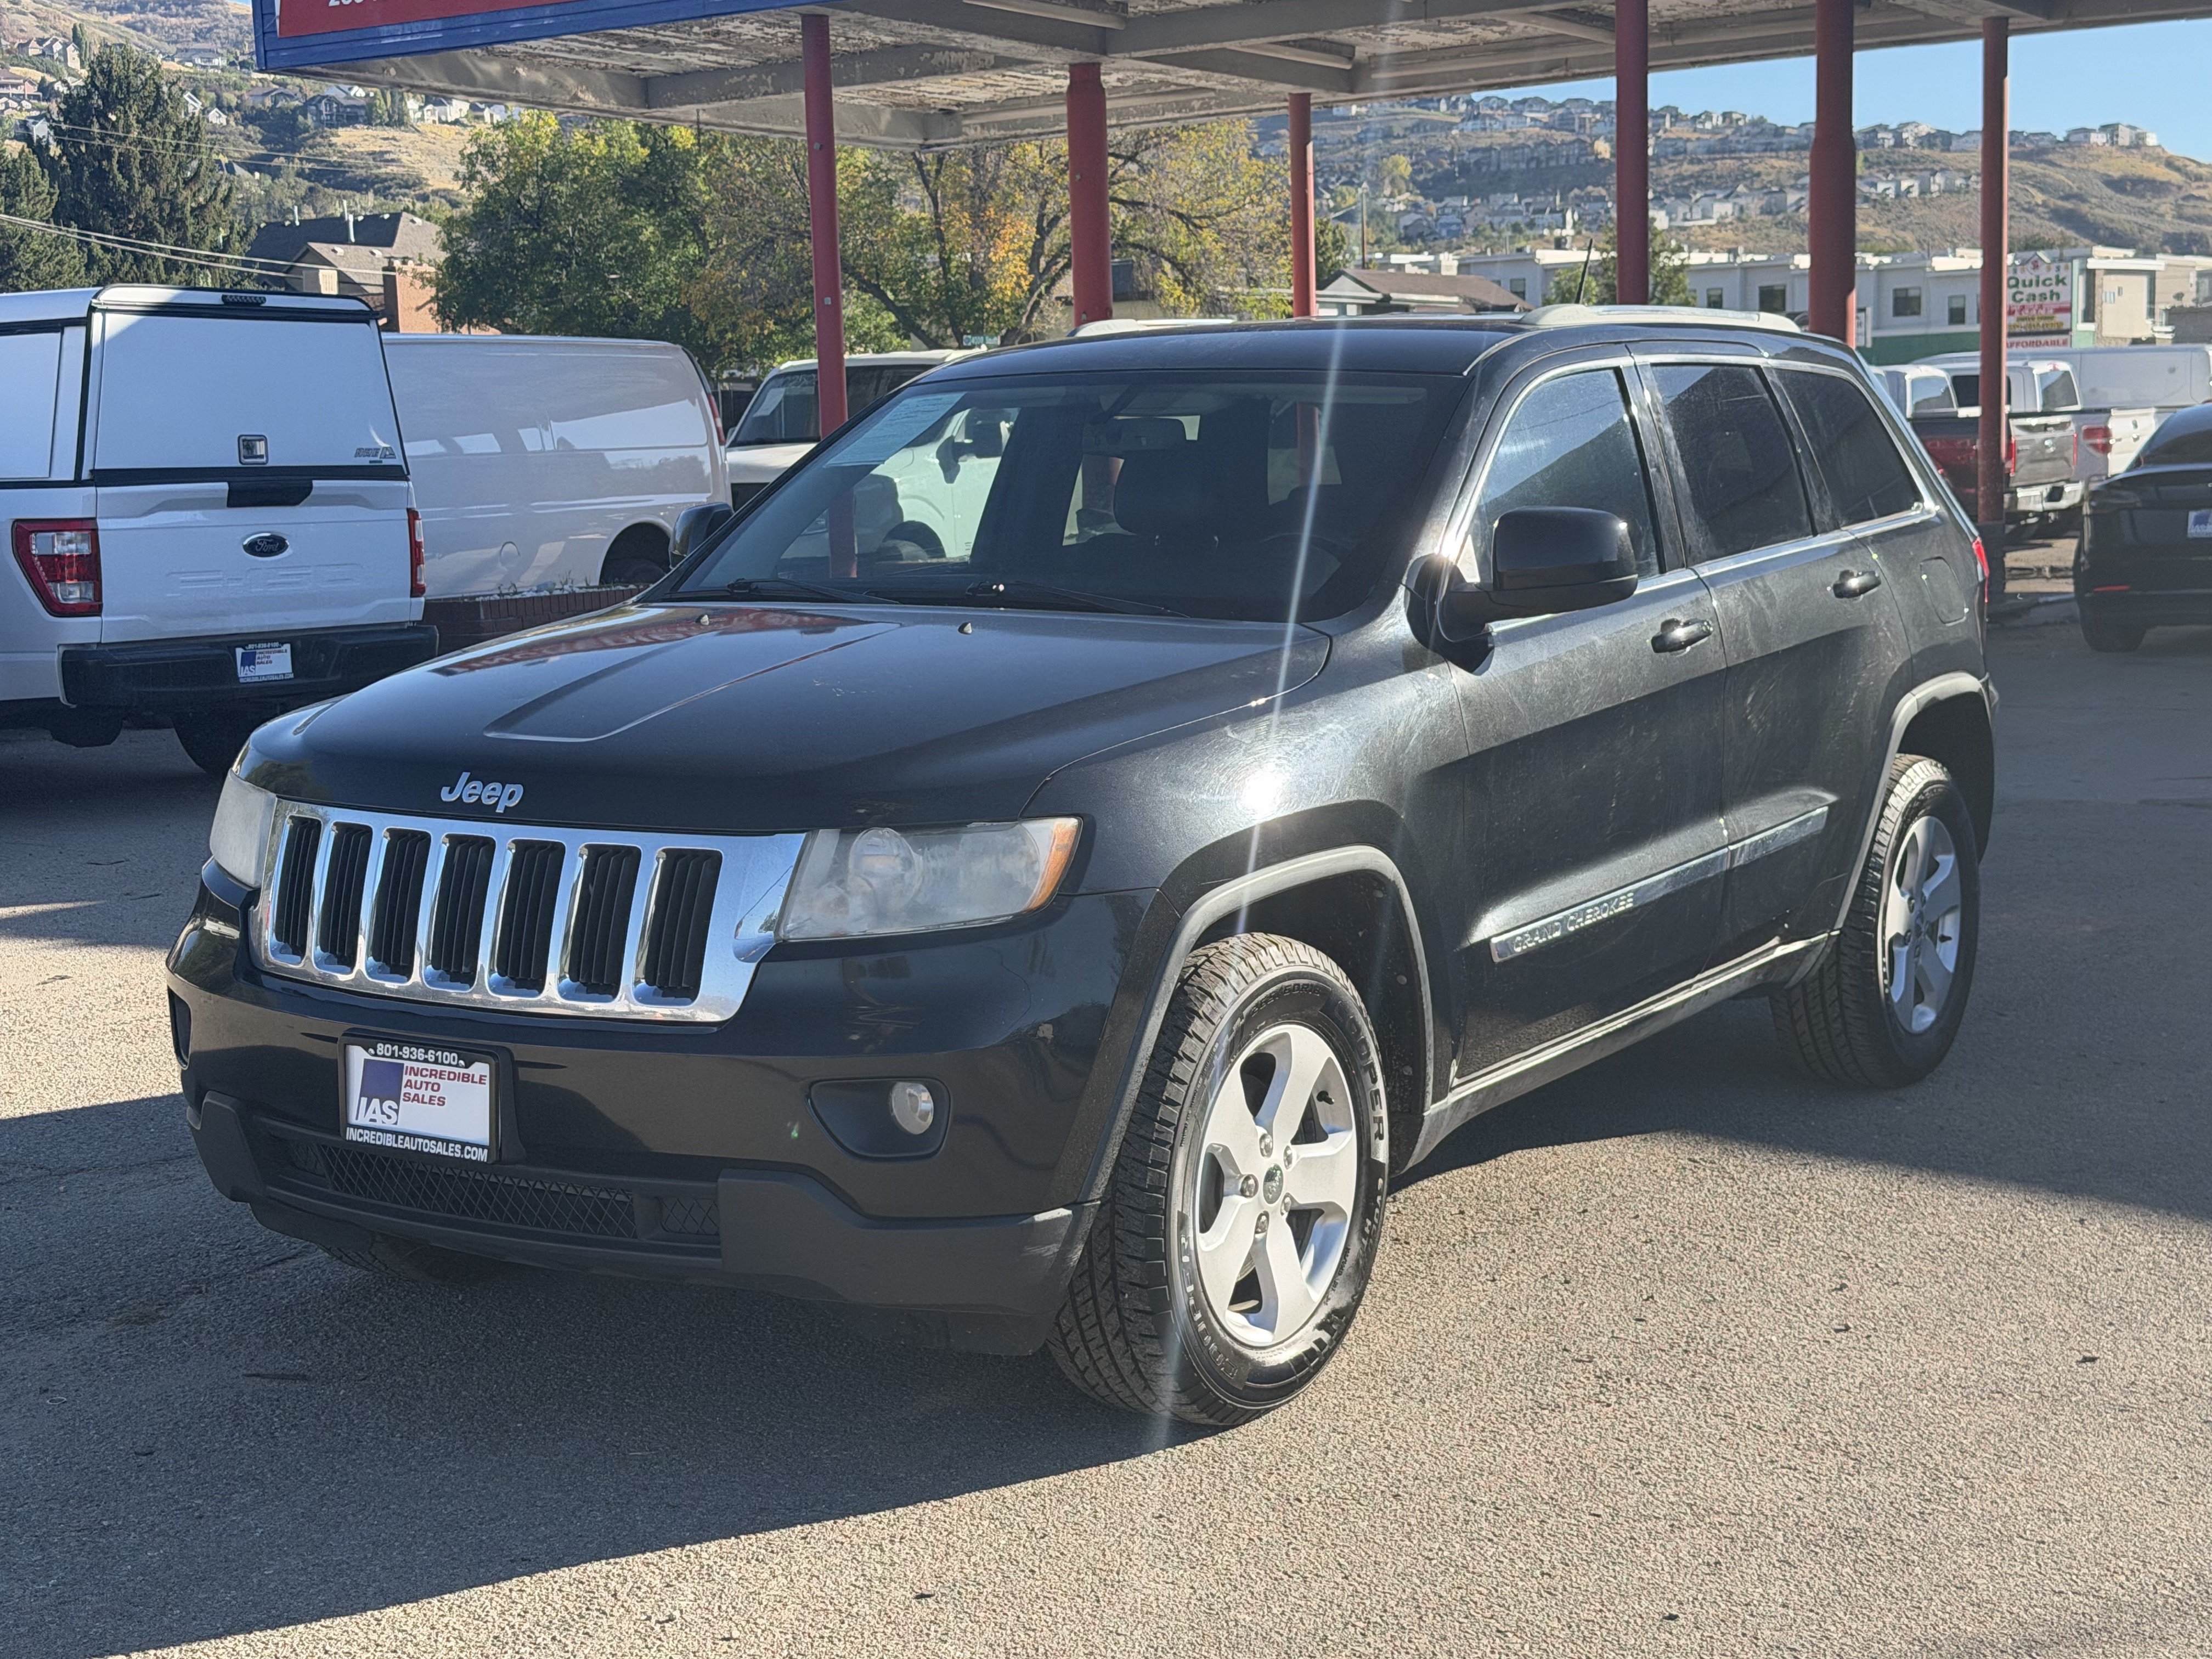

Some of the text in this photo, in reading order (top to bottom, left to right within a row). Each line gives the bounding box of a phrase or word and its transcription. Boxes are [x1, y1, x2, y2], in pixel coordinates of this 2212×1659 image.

[2007, 274, 2067, 289] Quick
[2012, 289, 2060, 303] Cash
[255, 538, 279, 552] Ford
[240, 665, 255, 675] IAS
[441, 772, 524, 813] Jeep
[1513, 892, 1634, 952] GRAND CHEROKEE
[377, 1043, 458, 1065] 801-936-6100
[404, 1065, 487, 1085] INCREDIBLE
[1334, 1000, 1385, 1142] COOPER
[403, 1079, 441, 1093] AUTO
[358, 1096, 398, 1124] IAS
[402, 1092, 446, 1107] SALES
[346, 1127, 488, 1163] INCREDIBLEAUTOSALES.COM
[1181, 1234, 1238, 1379] COOPER
